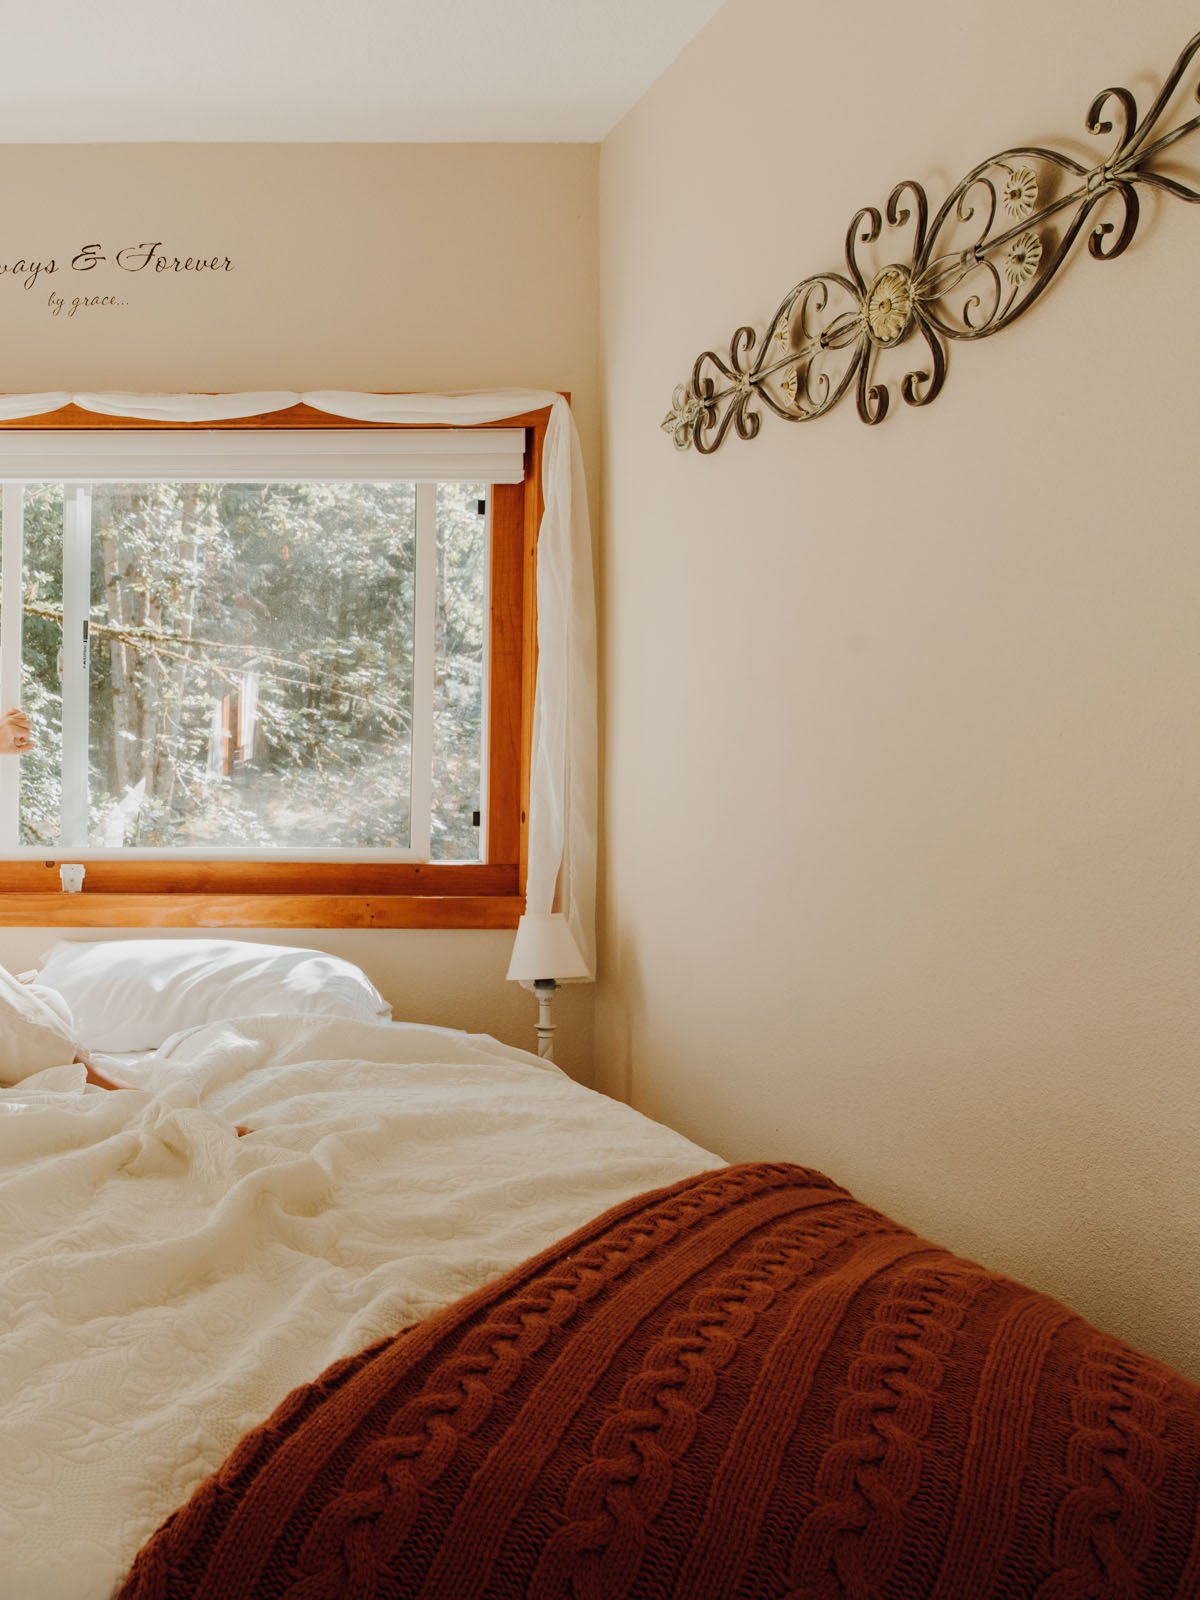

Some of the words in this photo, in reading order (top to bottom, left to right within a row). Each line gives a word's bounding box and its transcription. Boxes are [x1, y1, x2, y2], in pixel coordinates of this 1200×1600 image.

[71, 244, 106, 271] &
[116, 242, 234, 272] Forever
[47, 291, 64, 316] by
[68, 295, 129, 317] grace...
